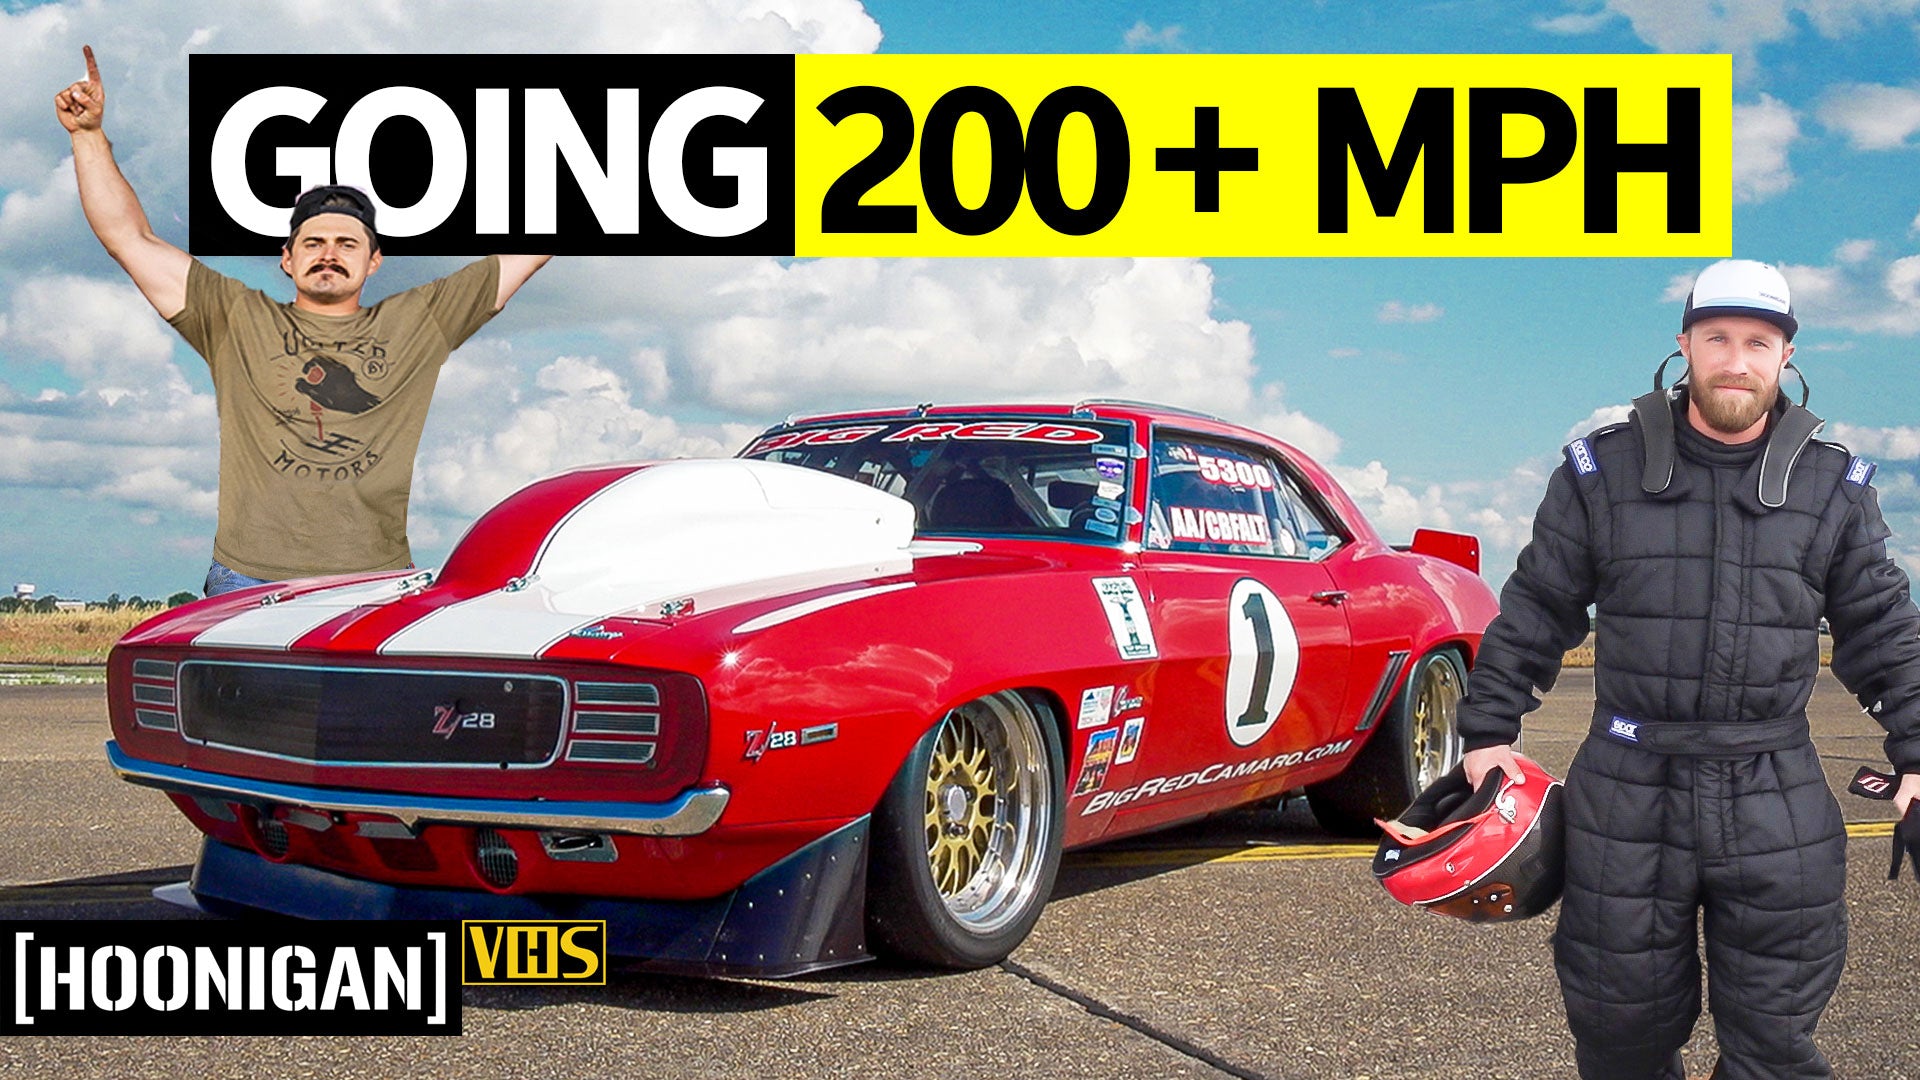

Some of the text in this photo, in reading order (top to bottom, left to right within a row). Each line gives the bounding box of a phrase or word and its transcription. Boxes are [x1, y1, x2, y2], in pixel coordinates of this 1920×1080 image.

[741, 423, 1103, 457] BIG RED
[274, 450, 378, 480] MOTORS
[1198, 455, 1274, 491] 5300
[1236, 593, 1275, 727] 1
[432, 706, 495, 739] Z/28
[746, 721, 797, 762] Z/28
